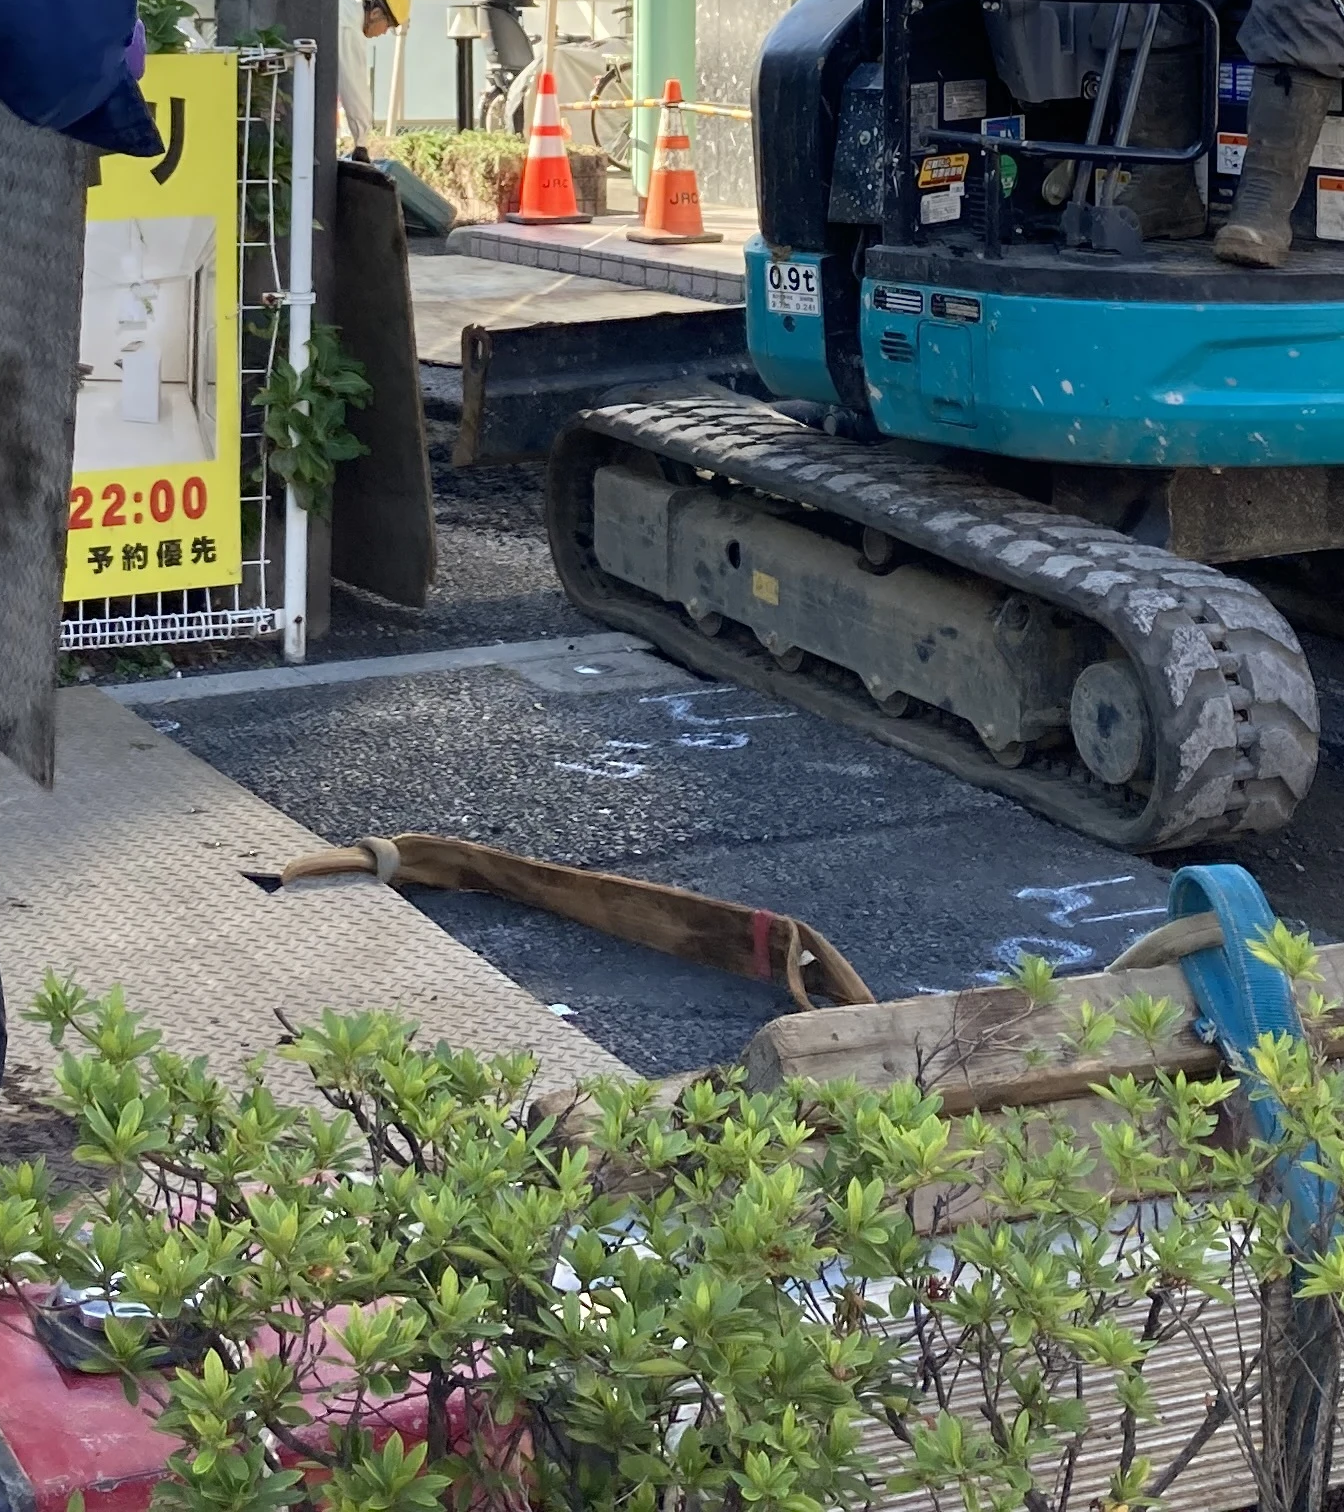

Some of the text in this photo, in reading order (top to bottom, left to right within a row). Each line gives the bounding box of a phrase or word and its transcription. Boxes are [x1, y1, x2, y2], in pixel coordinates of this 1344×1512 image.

[769, 265, 815, 292] 0.9t
[87, 535, 217, 575] 予約優先
